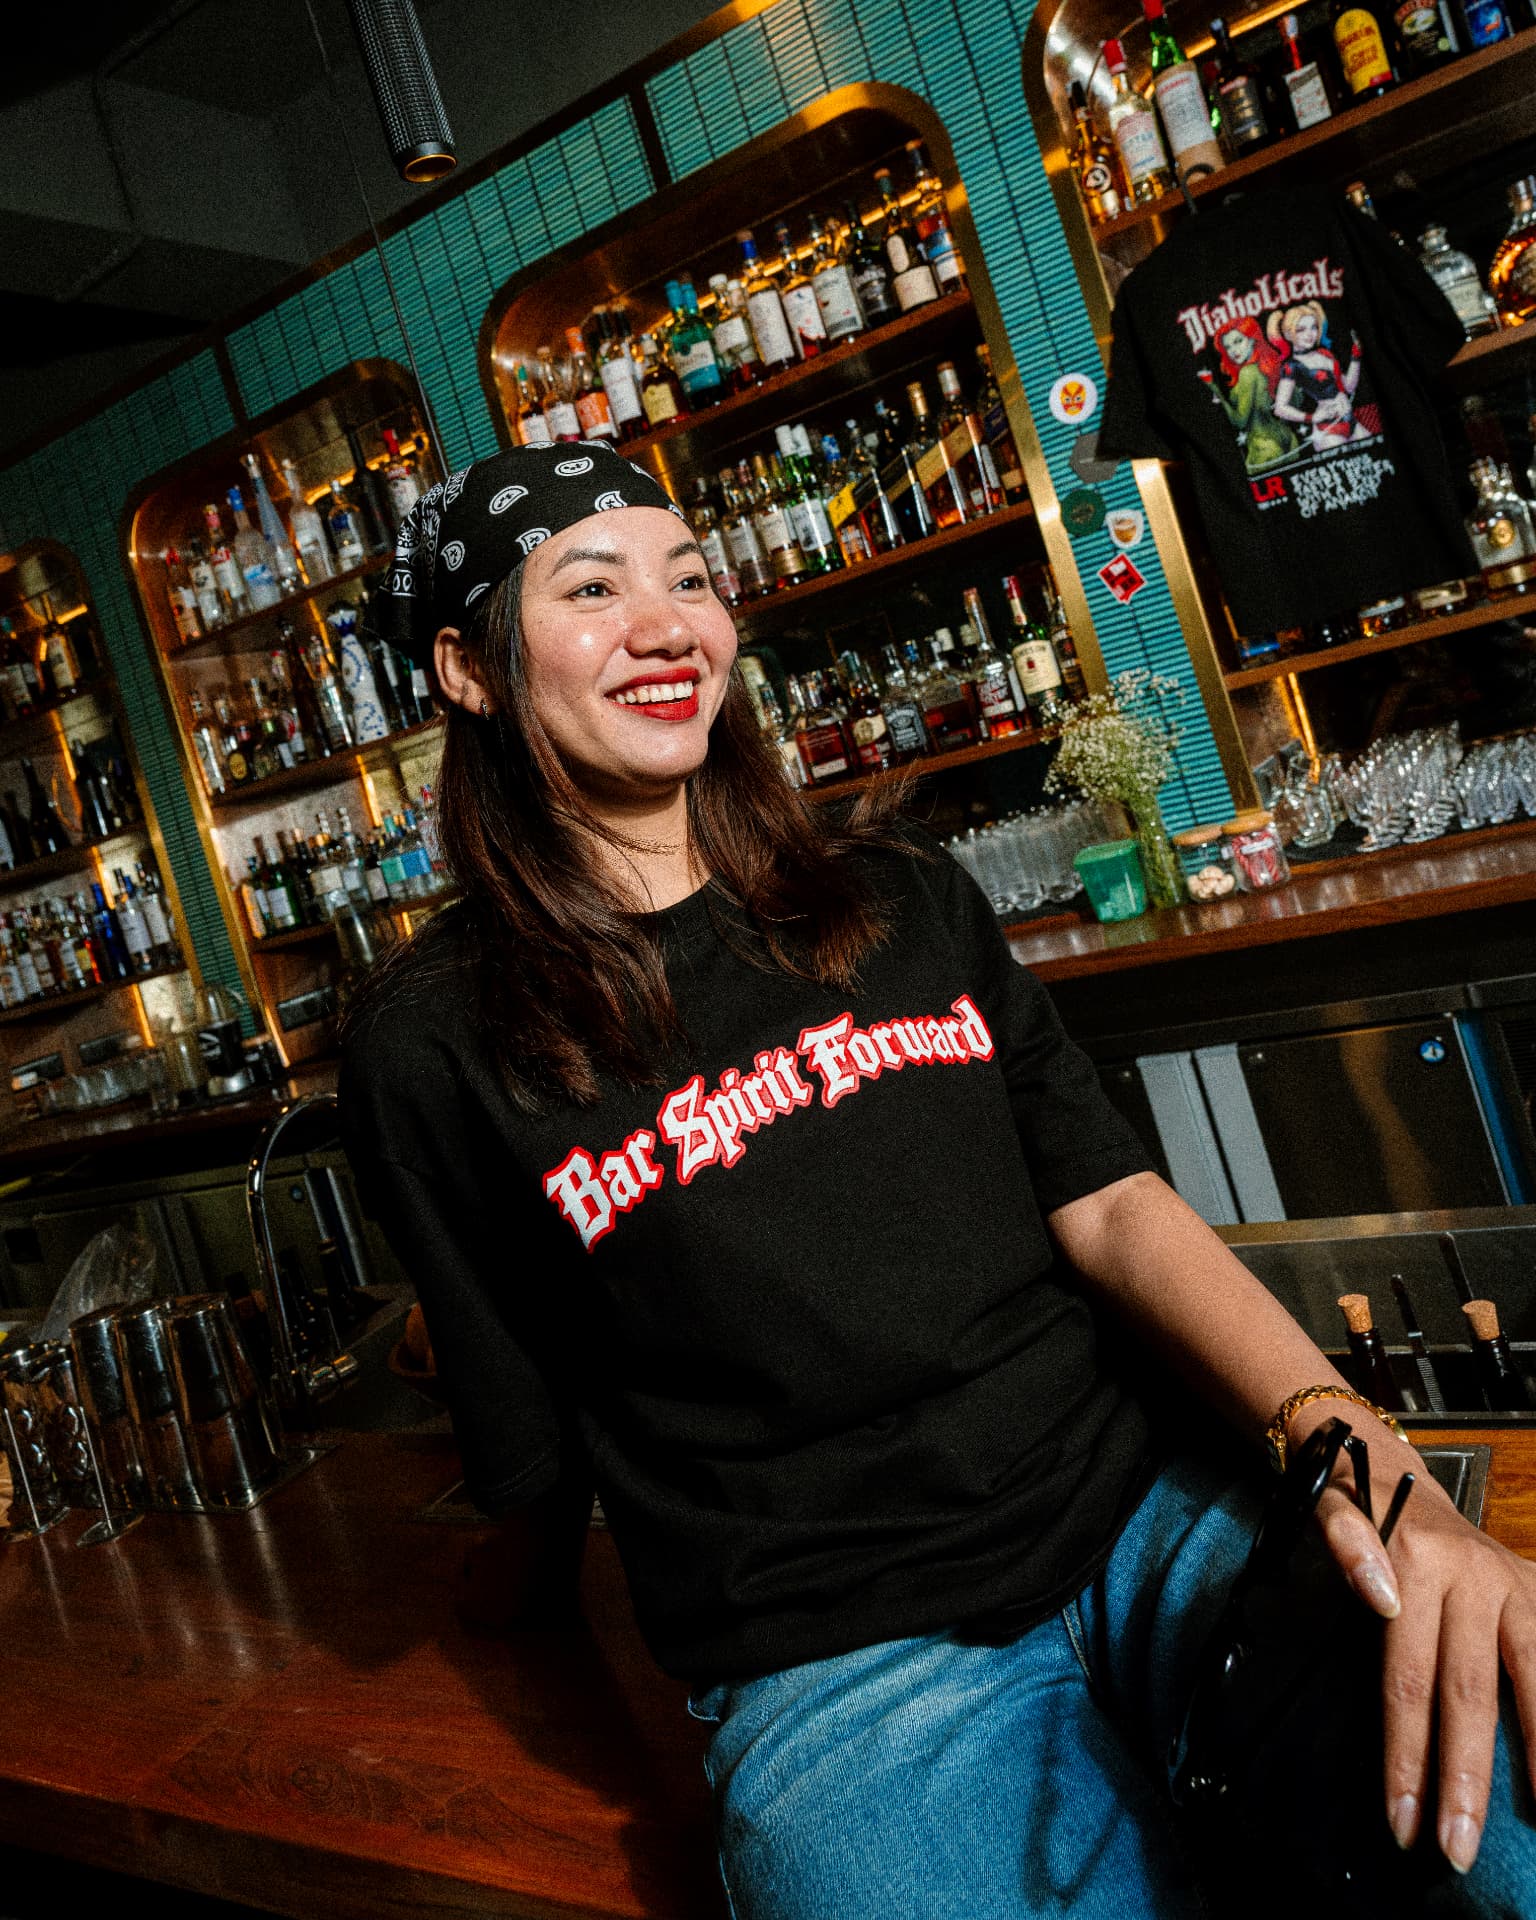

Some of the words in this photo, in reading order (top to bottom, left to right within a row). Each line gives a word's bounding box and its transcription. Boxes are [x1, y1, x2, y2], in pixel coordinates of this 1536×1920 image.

[1249, 475, 1287, 503] LR
[543, 1129, 664, 1253] Bar
[657, 1047, 813, 1185] Spirit
[797, 994, 995, 1109] Forward
